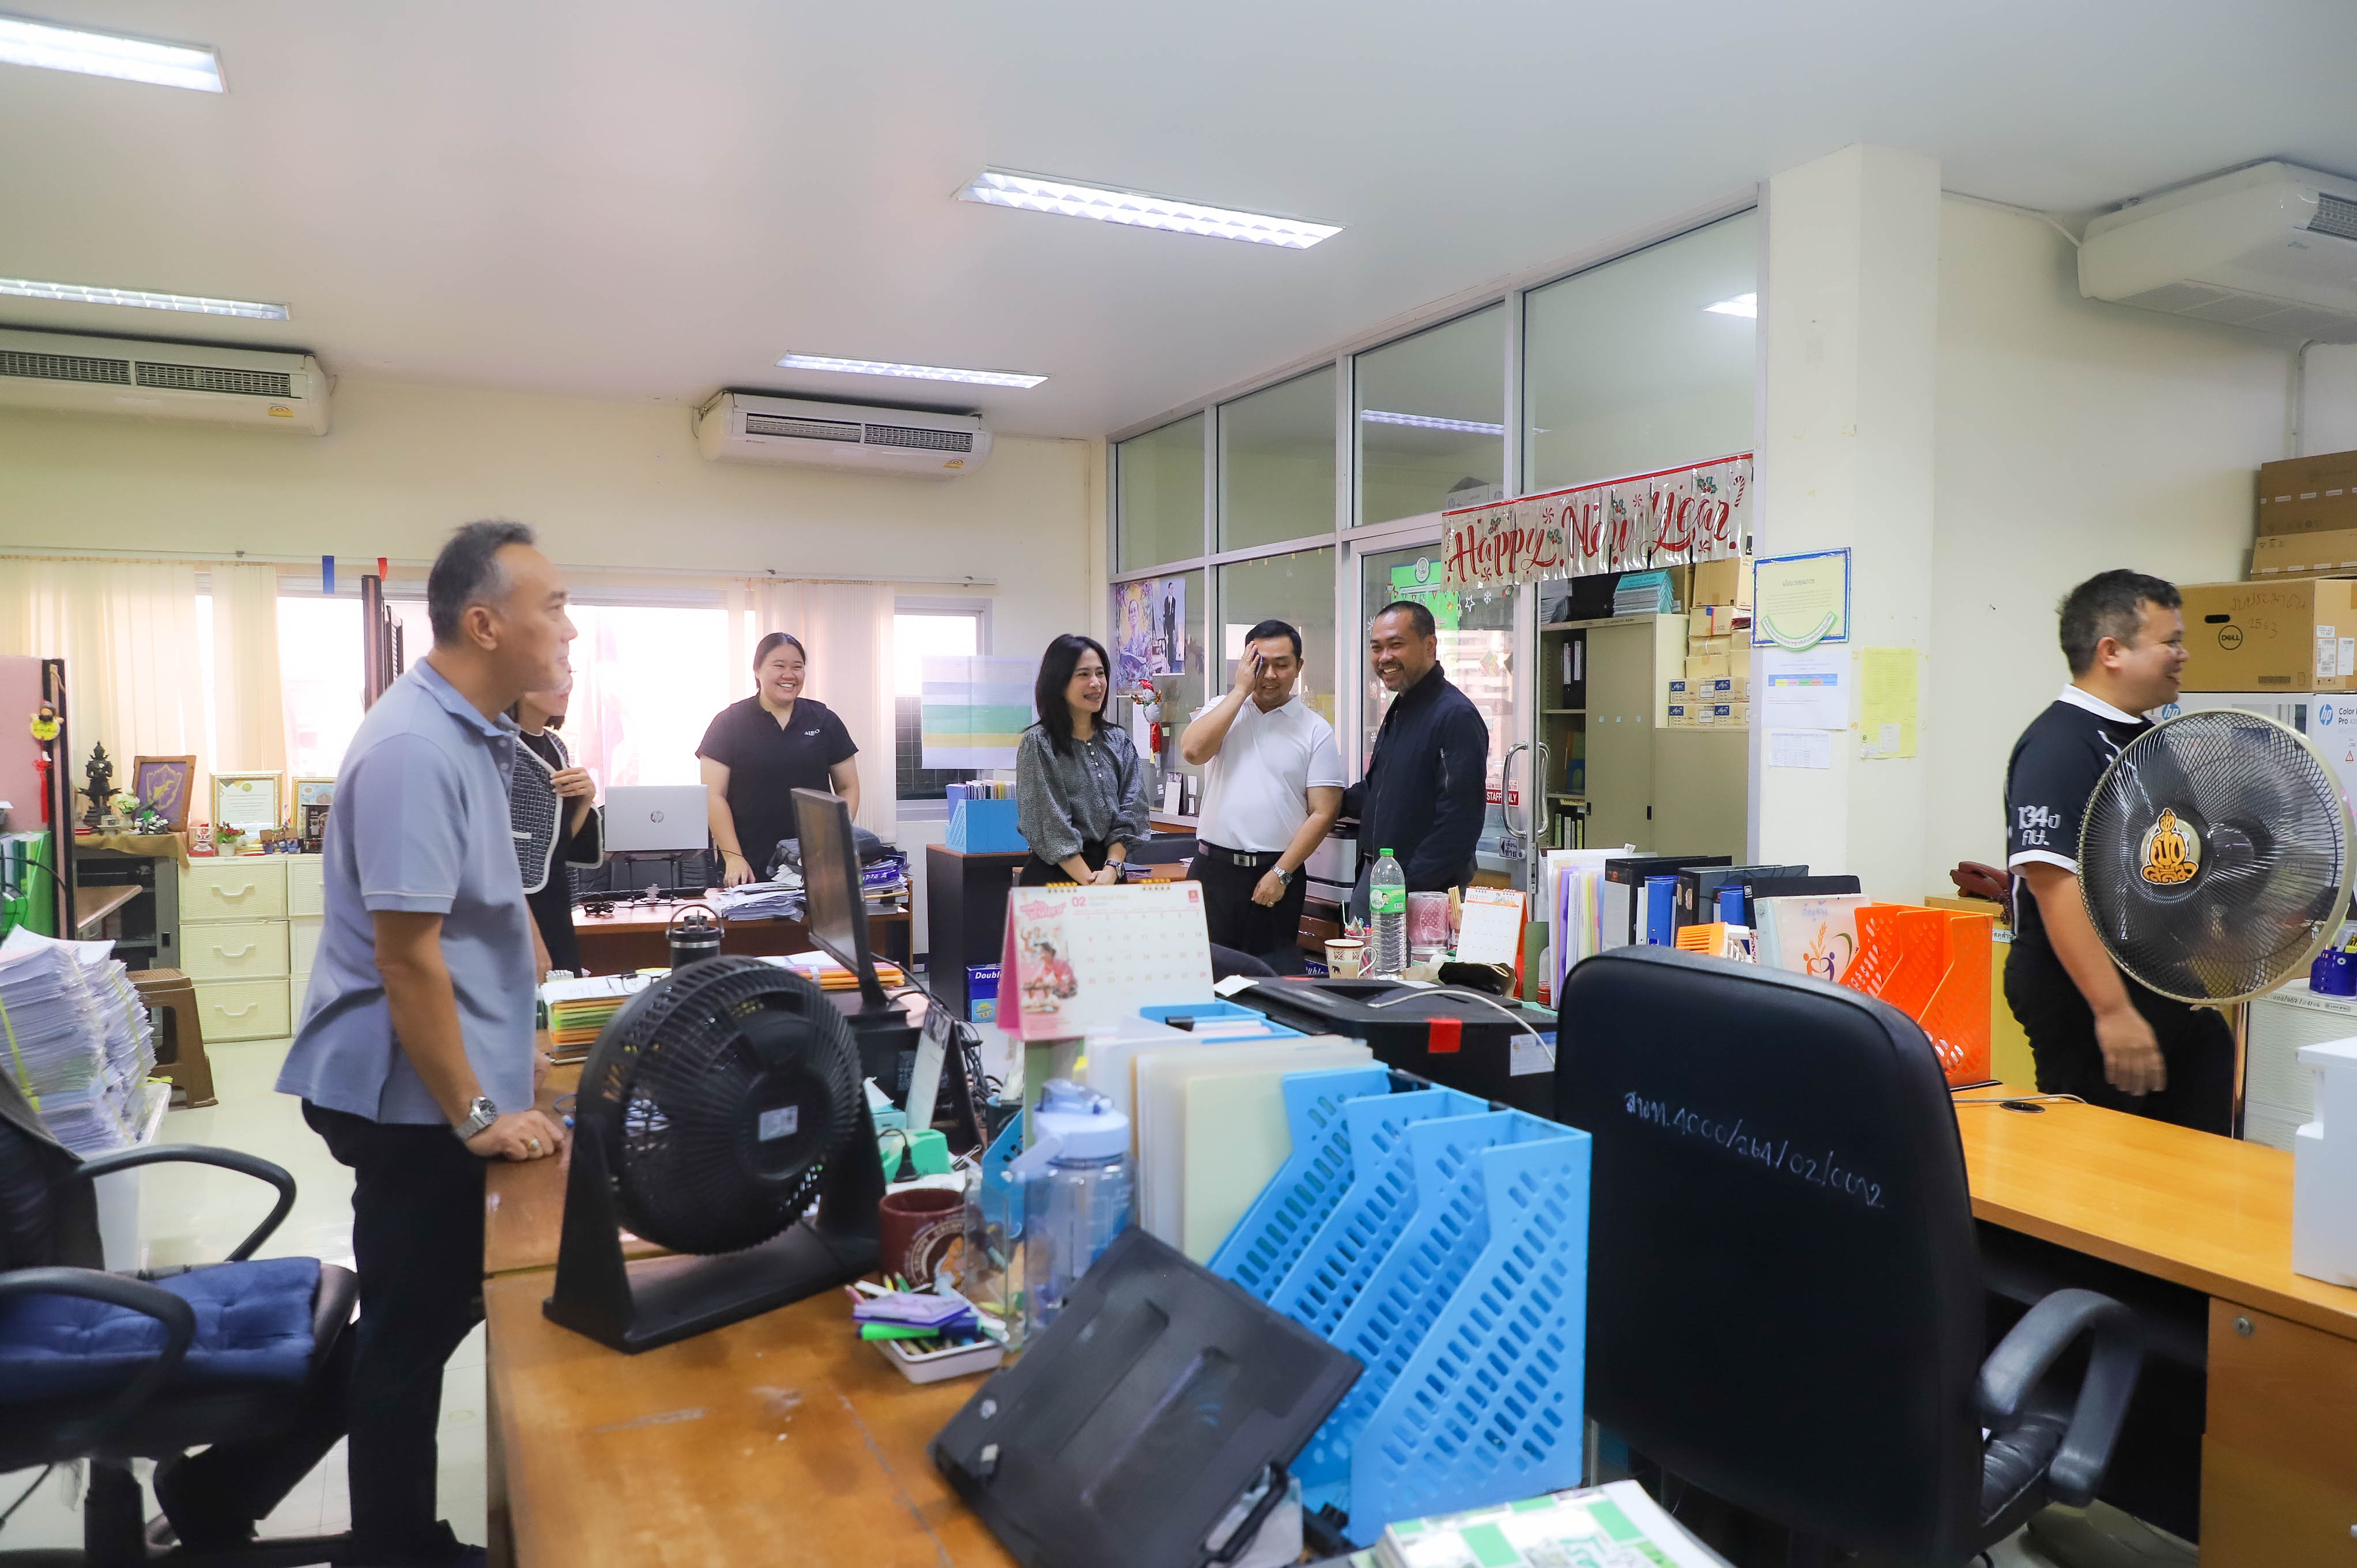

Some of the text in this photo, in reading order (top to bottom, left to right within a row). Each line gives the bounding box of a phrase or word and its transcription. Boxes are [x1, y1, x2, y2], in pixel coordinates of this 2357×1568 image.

[1449, 490, 1730, 582] Happy New Year
[2320, 704, 2333, 726] hp
[1486, 792, 1517, 803] STAFF NLY
[651, 810, 664, 823] hp
[1505, 847, 1517, 857] ซ้าย
[1072, 896, 1087, 907] 02
[975, 971, 1001, 980] Doubl
